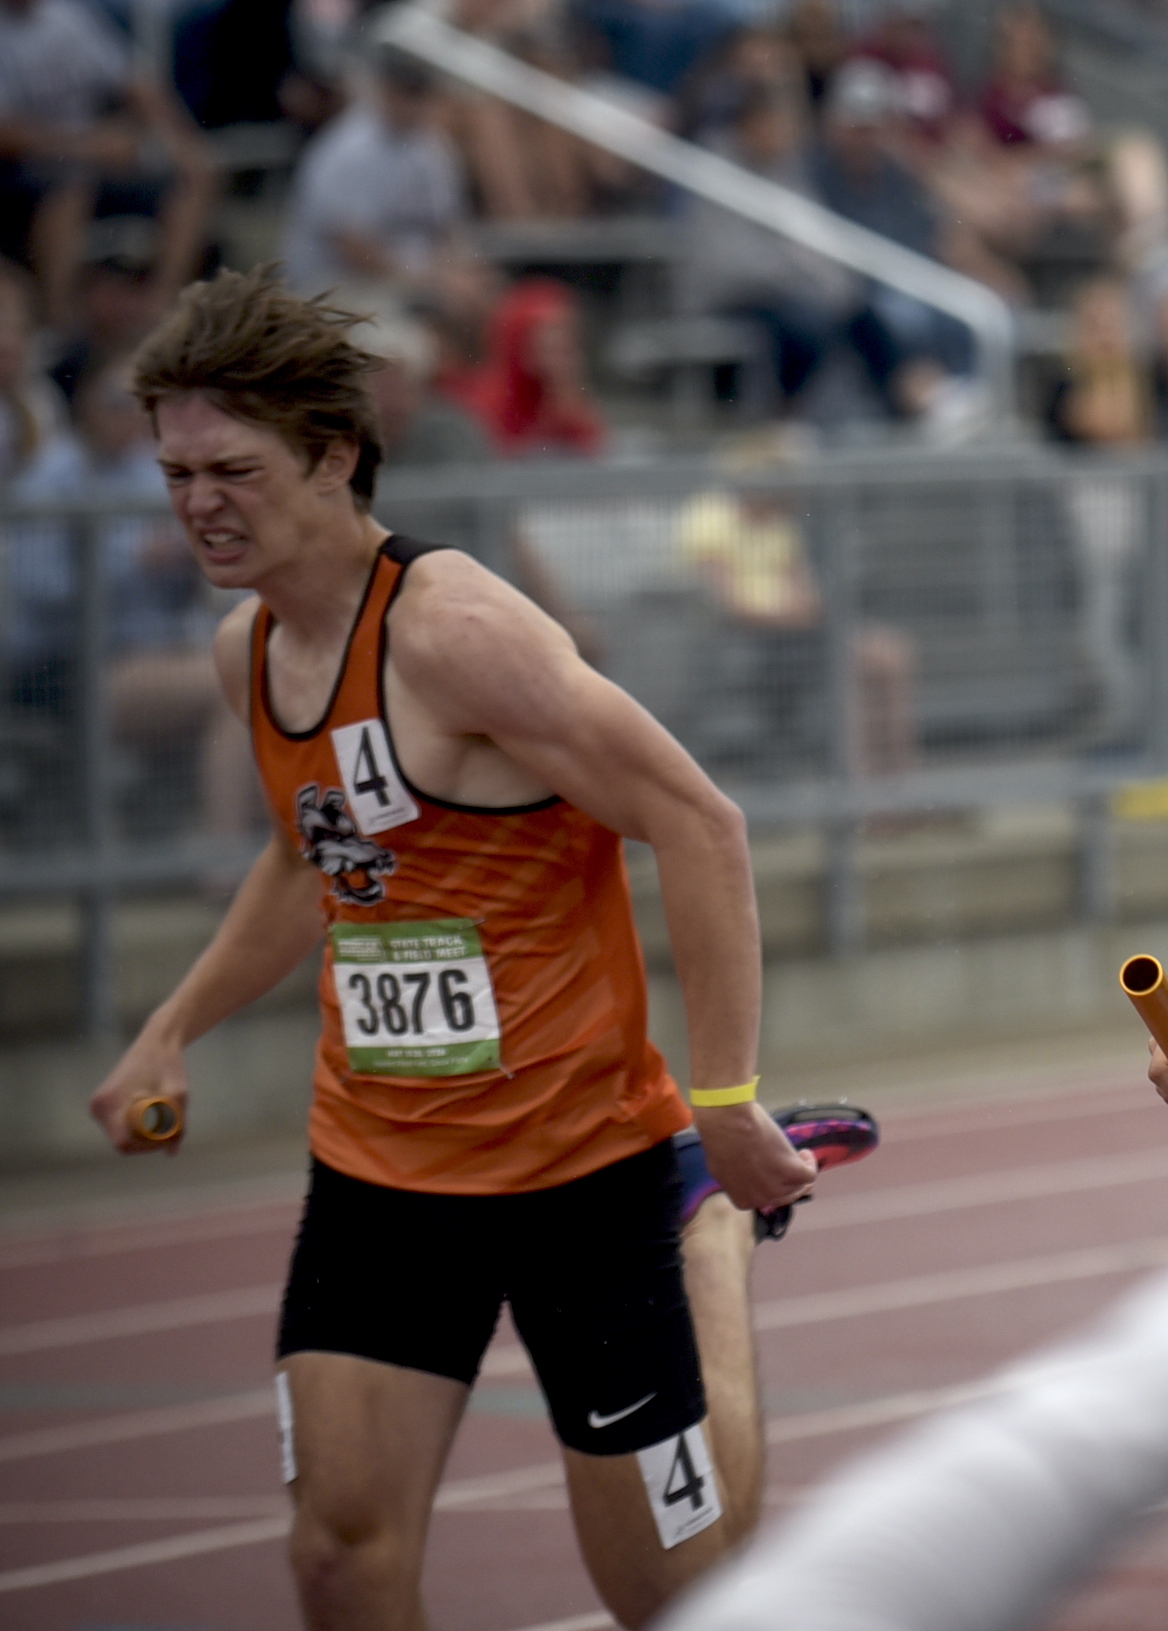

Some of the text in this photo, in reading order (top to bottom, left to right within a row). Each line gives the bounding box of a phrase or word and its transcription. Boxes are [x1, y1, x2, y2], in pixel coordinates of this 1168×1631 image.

[353, 726, 390, 807] 4
[422, 935, 463, 948] TRACK
[436, 946, 467, 958] MEET
[348, 968, 476, 1037] 3876
[663, 1432, 704, 1511] 4
